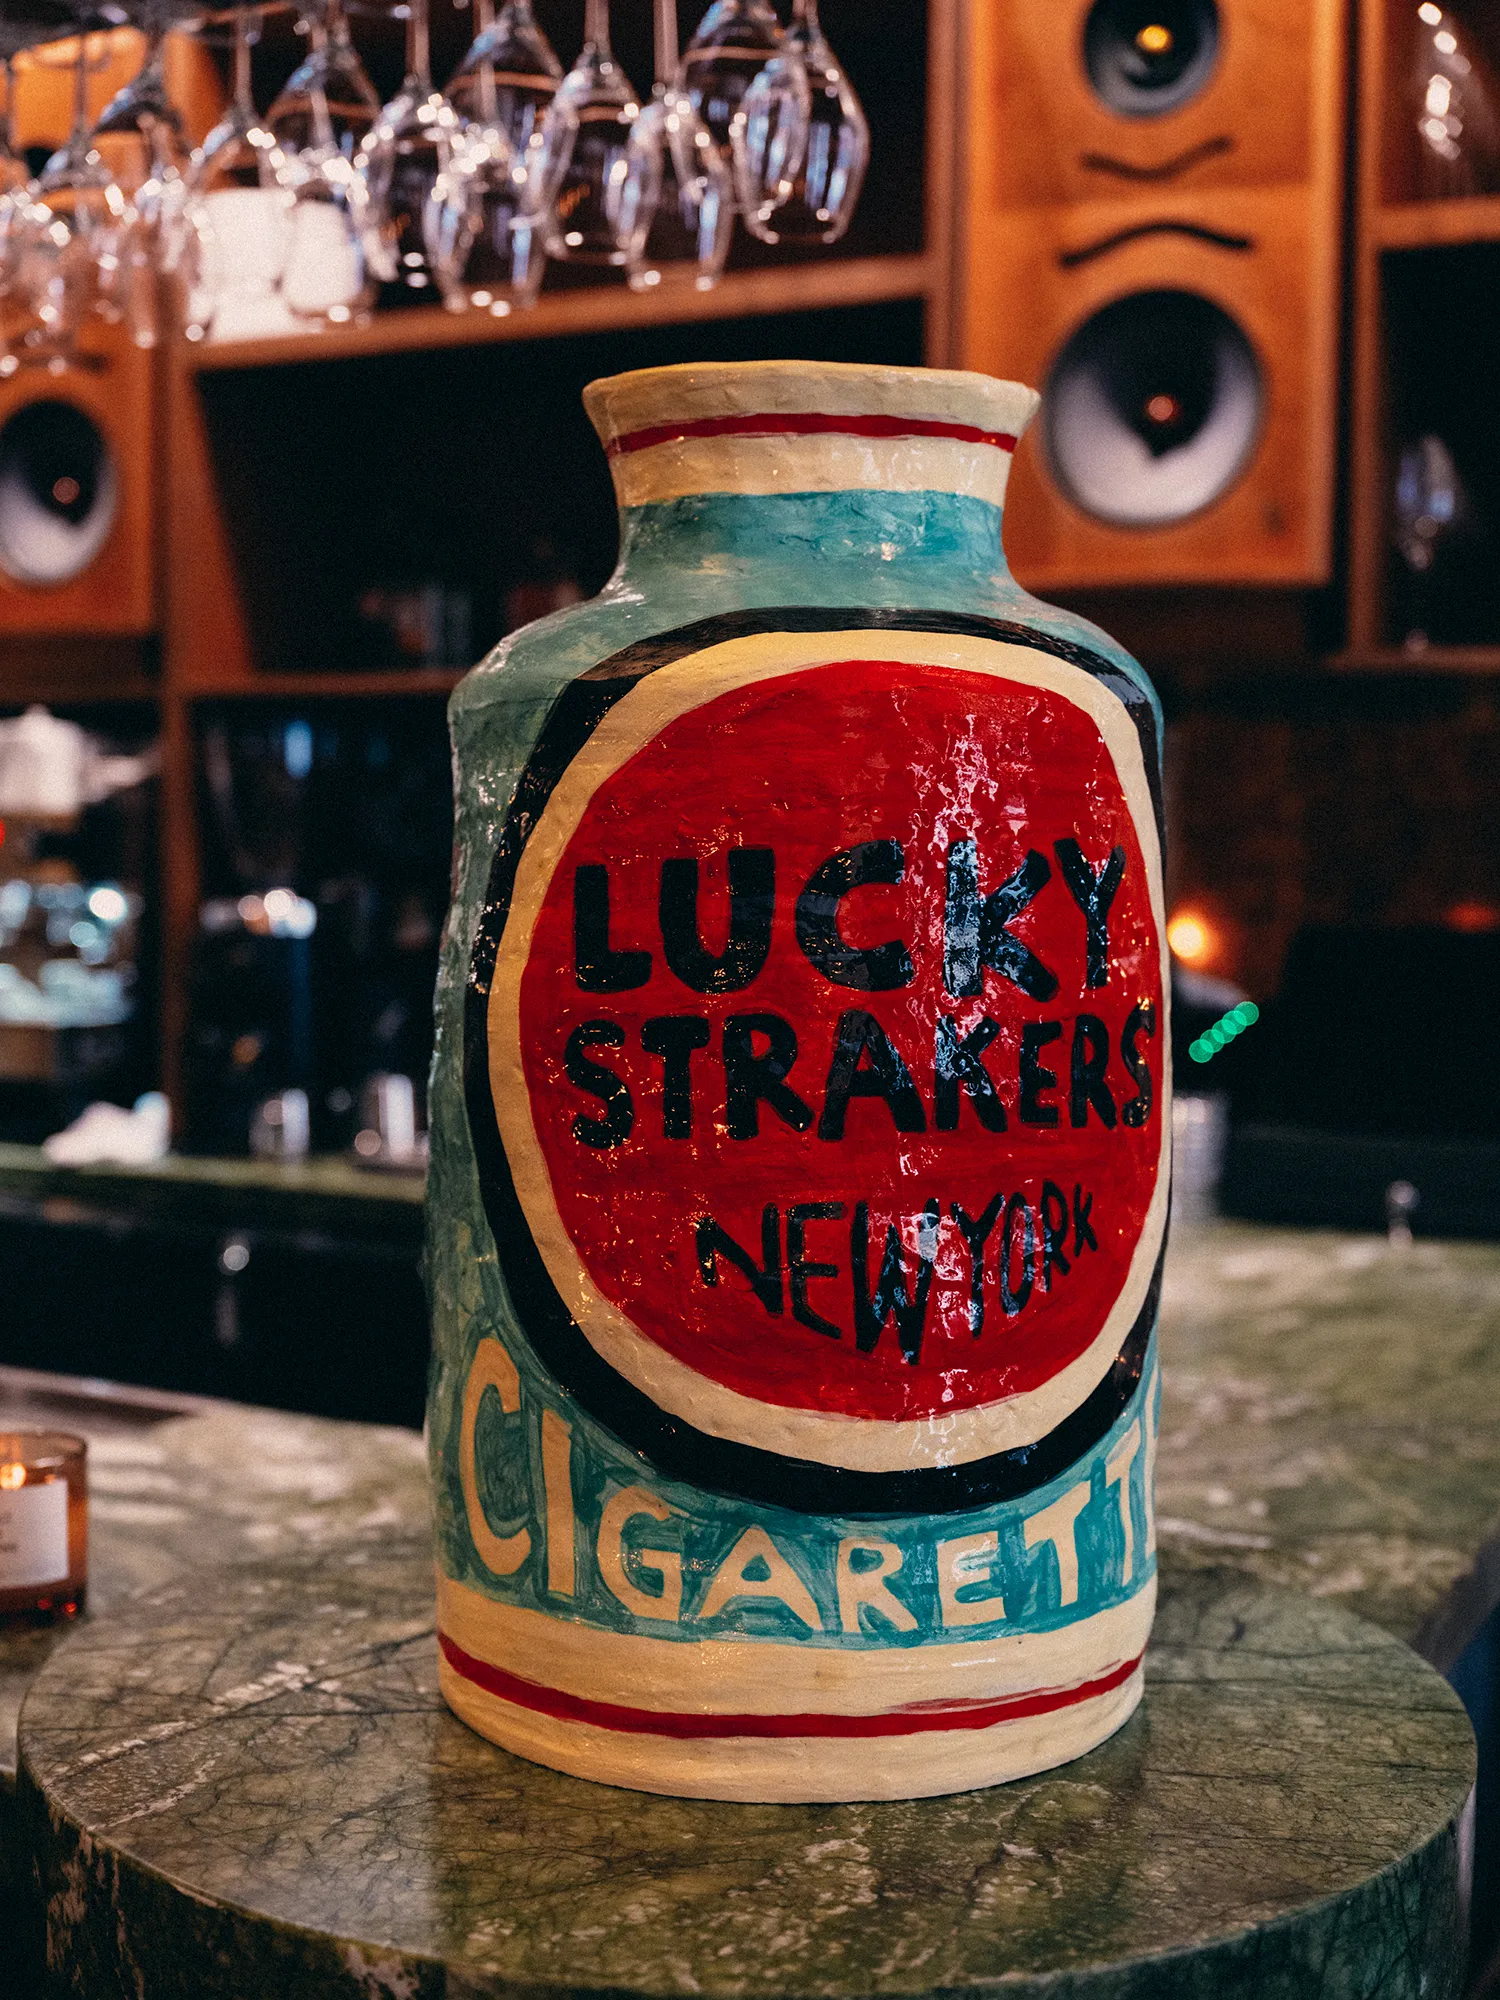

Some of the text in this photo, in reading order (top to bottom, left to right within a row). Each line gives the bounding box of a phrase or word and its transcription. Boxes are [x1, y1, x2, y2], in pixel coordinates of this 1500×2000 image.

[573, 838, 1125, 1001] LUCKY
[563, 998, 1155, 1149] STRAKERS
[696, 1179, 1098, 1365] NEW YORK
